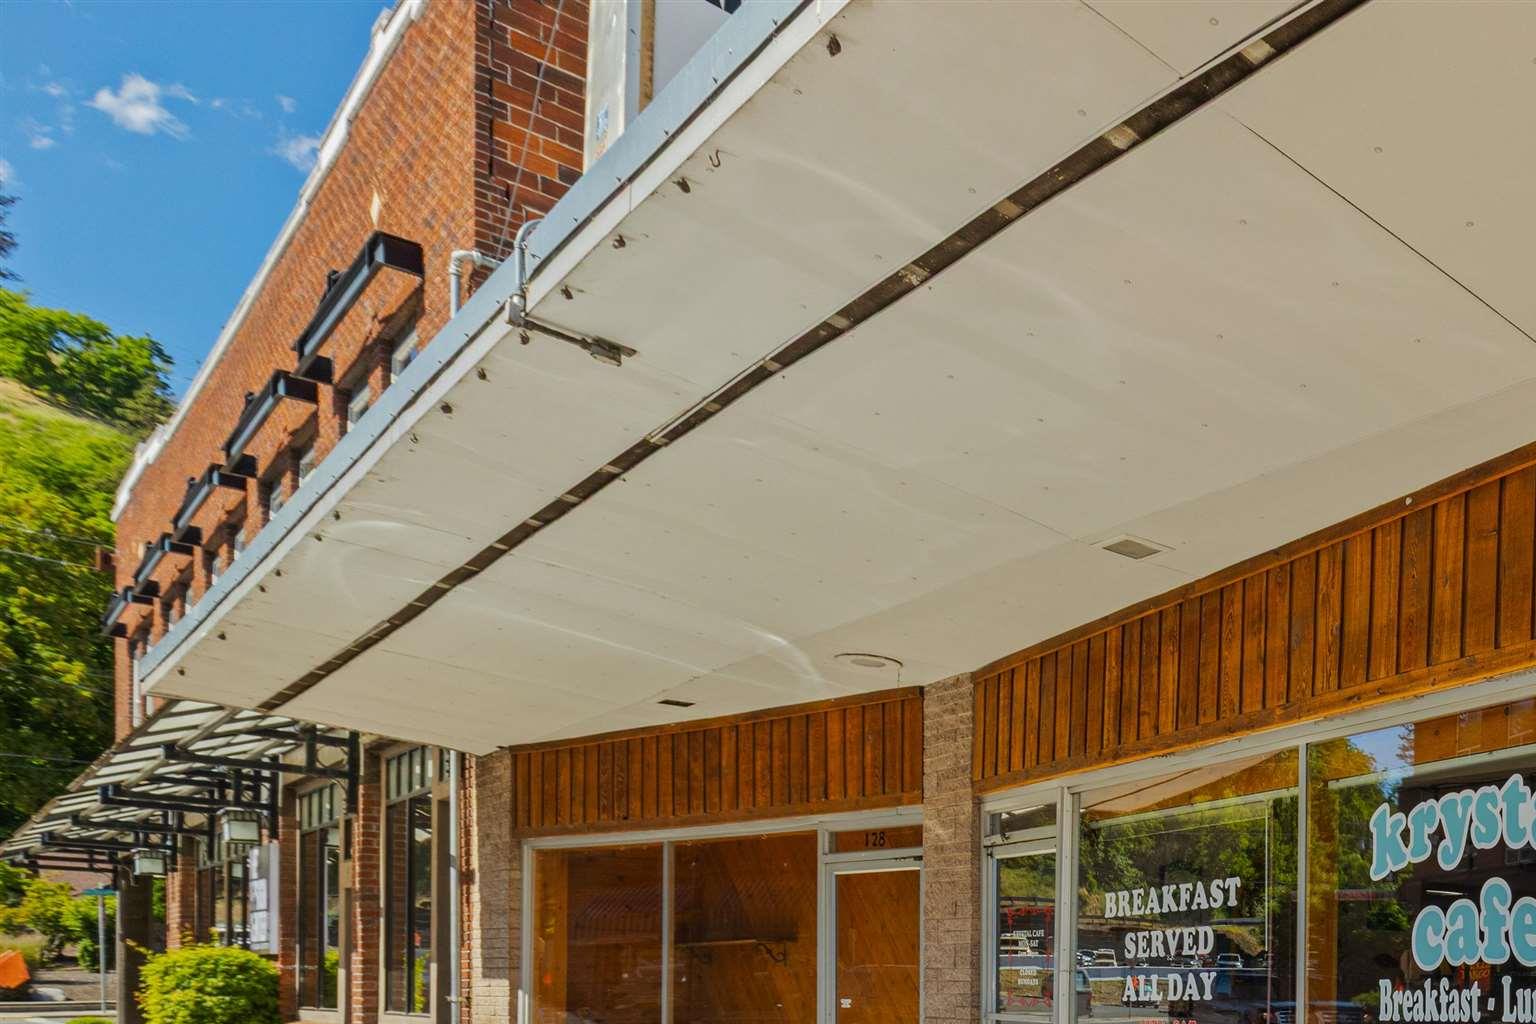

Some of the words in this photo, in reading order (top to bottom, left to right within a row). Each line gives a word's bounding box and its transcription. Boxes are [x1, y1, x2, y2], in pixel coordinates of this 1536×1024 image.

[864, 832, 887, 847] 128
[1104, 876, 1241, 918] BREAKFAST
[1124, 926, 1215, 959] SERVED
[1122, 974, 1163, 1001] ALL
[1167, 971, 1217, 1001] DAY
[1378, 977, 1481, 1022] Breakfast
